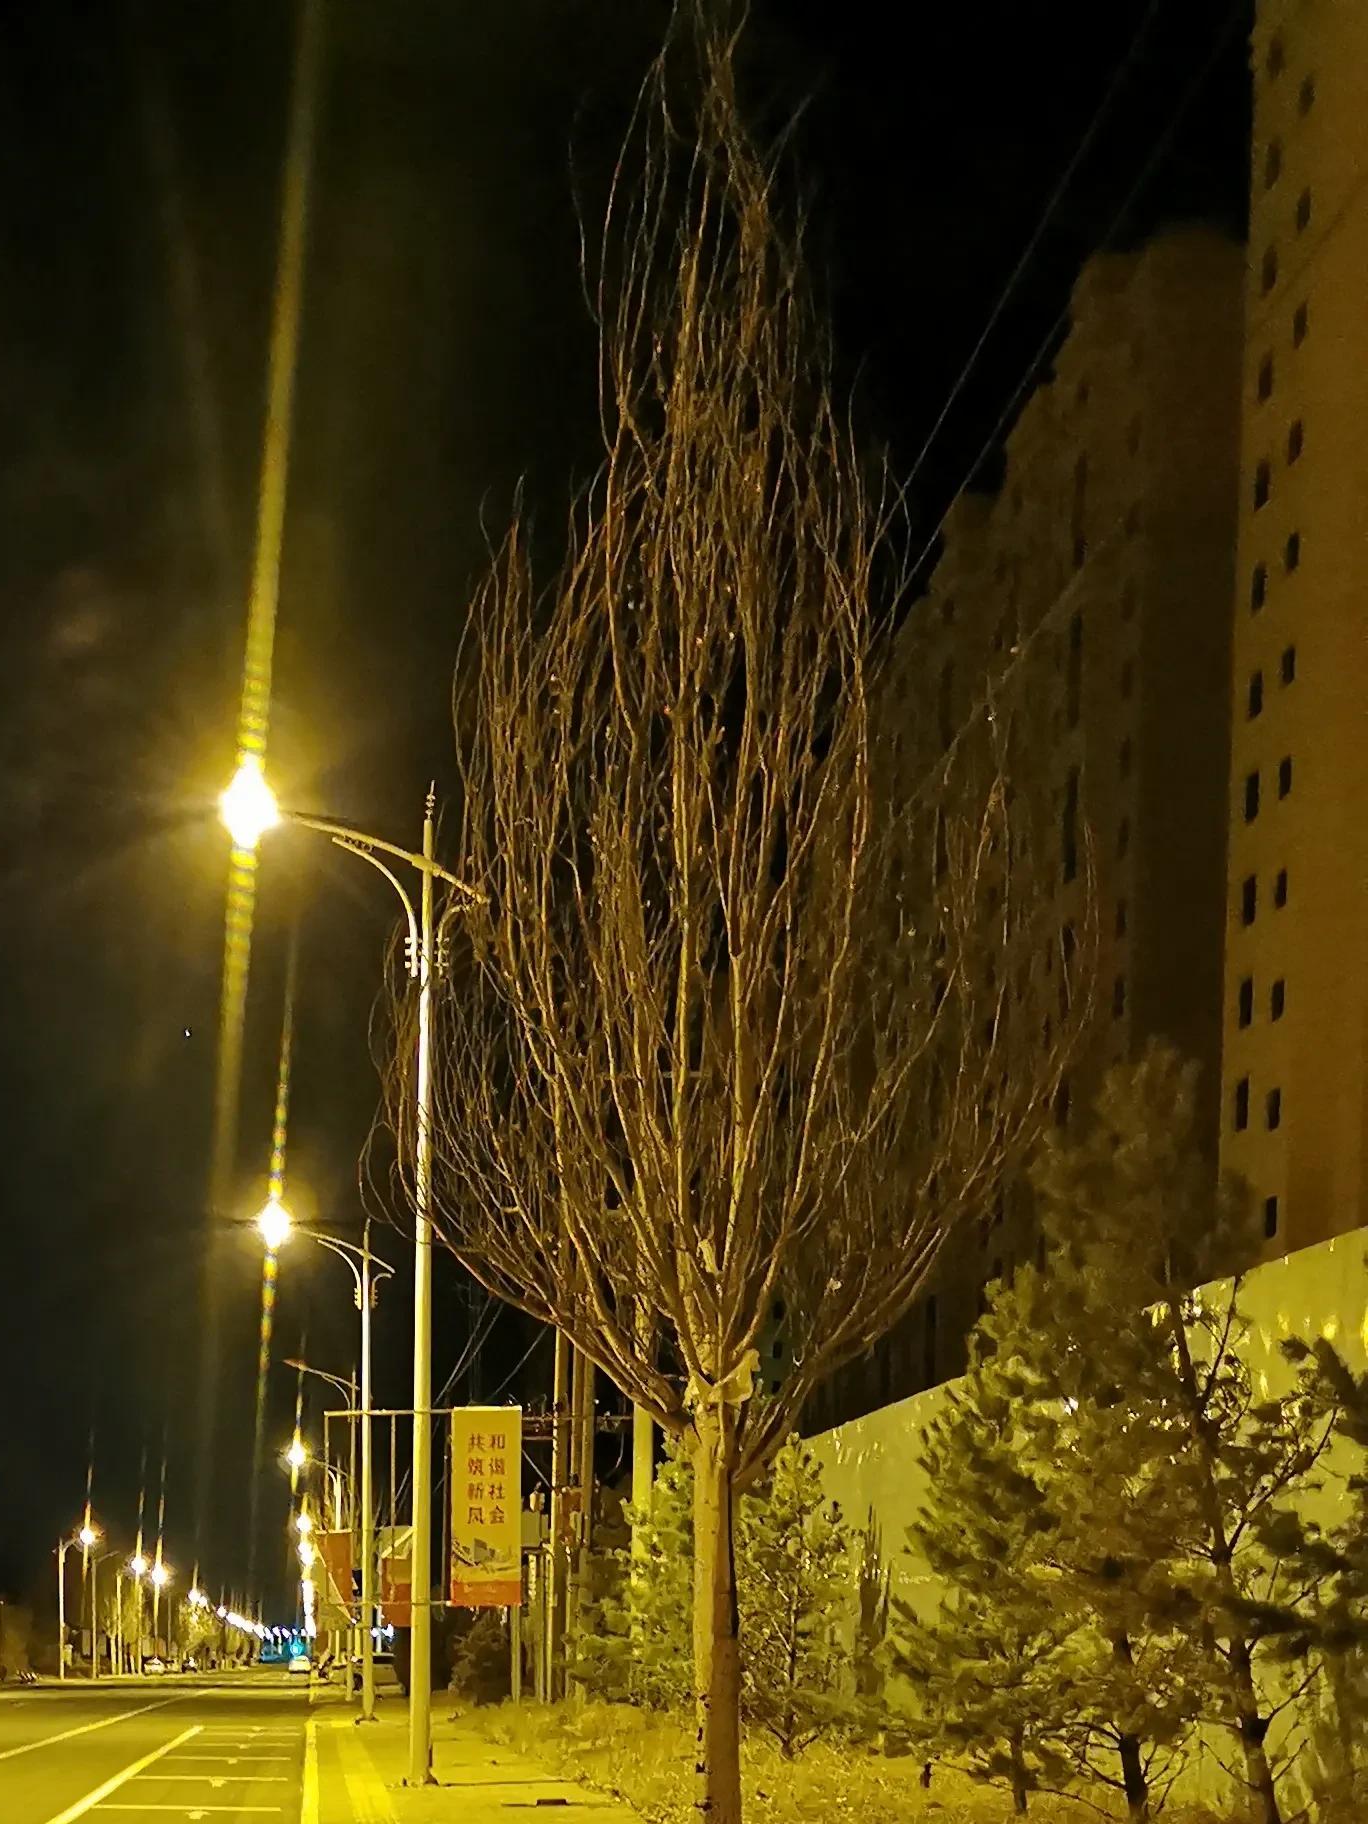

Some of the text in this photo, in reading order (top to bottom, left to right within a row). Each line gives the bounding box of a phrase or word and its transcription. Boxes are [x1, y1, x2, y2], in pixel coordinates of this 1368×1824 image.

[467, 1433, 485, 1525] 共筑新风
[488, 1433, 505, 1524] 和谐社会
